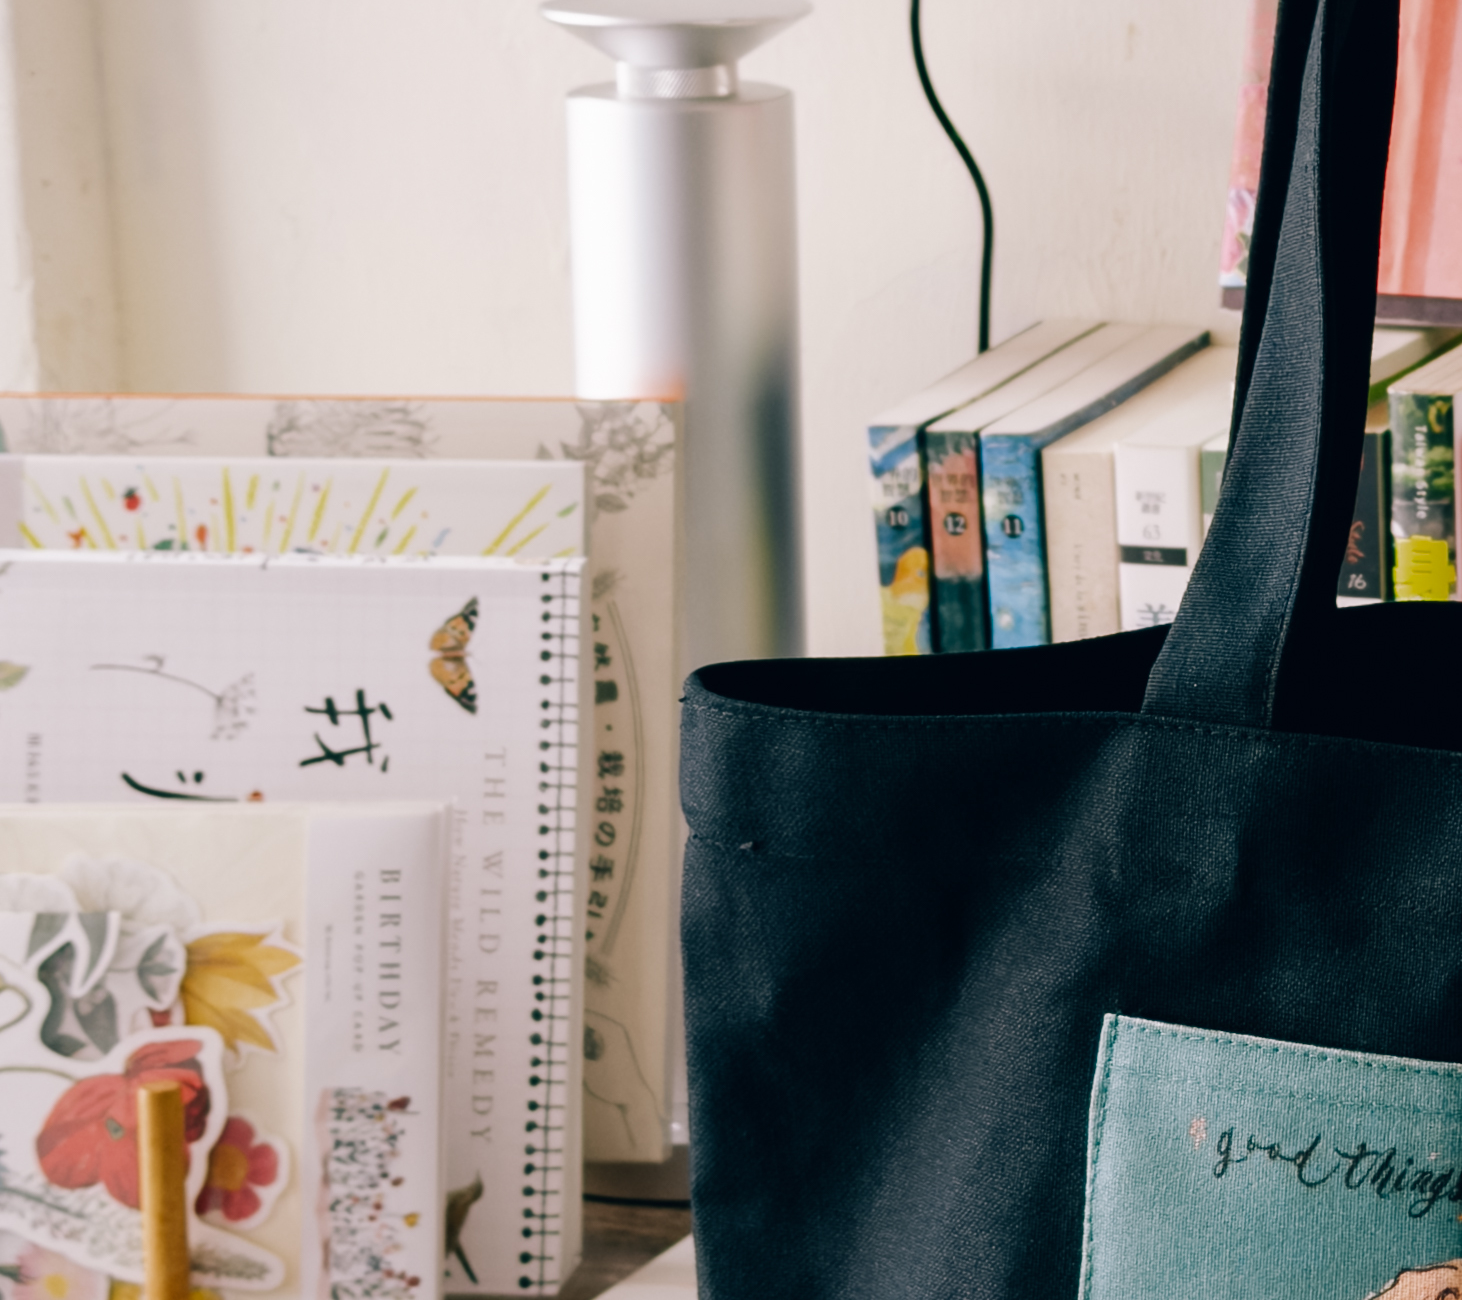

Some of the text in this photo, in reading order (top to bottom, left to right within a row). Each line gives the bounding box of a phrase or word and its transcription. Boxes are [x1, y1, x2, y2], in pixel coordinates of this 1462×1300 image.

[944, 516, 966, 535] 12
[1003, 518, 1023, 535] 11
[477, 850, 504, 956] WILD
[378, 869, 402, 1055] BIRTHDAY
[468, 978, 500, 1145] REMEDY
[1213, 1127, 1338, 1188] good
